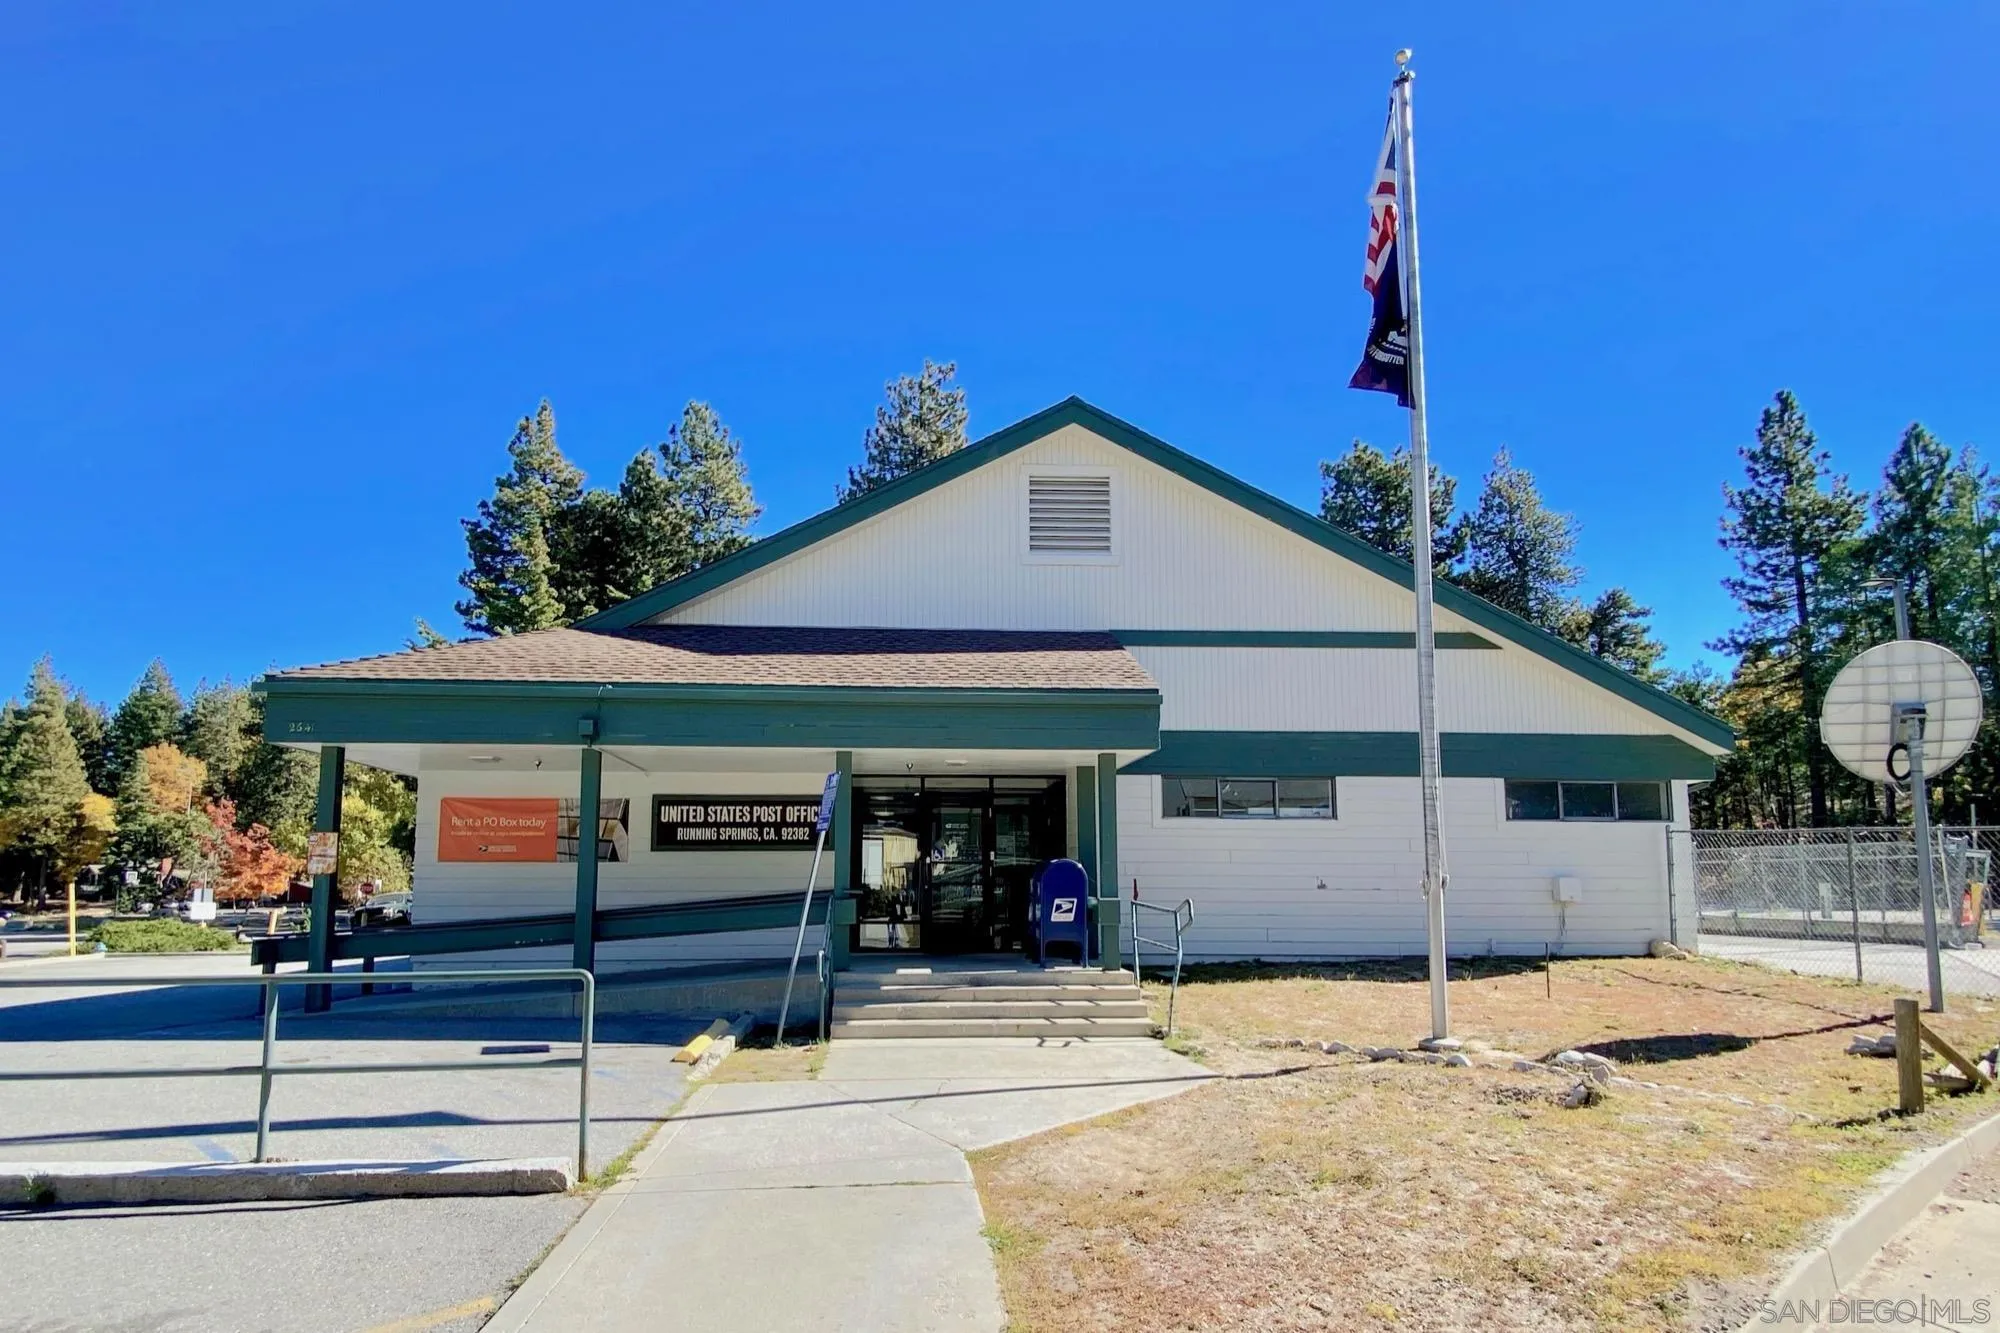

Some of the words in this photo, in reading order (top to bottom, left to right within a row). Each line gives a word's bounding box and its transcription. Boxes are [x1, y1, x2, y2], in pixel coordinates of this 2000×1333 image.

[660, 805, 705, 823] UNITED
[707, 805, 750, 823] STATES
[752, 805, 783, 823] POST
[785, 805, 821, 823] OFFIC
[451, 816, 474, 826] Rent
[474, 818, 481, 827] a
[483, 816, 498, 827] PO
[499, 816, 518, 827] Box
[519, 817, 546, 829] today
[677, 827, 717, 841] RUNNING
[719, 827, 762, 842] SPRINGS,
[763, 827, 778, 841] CA.
[781, 827, 810, 840] 92382
